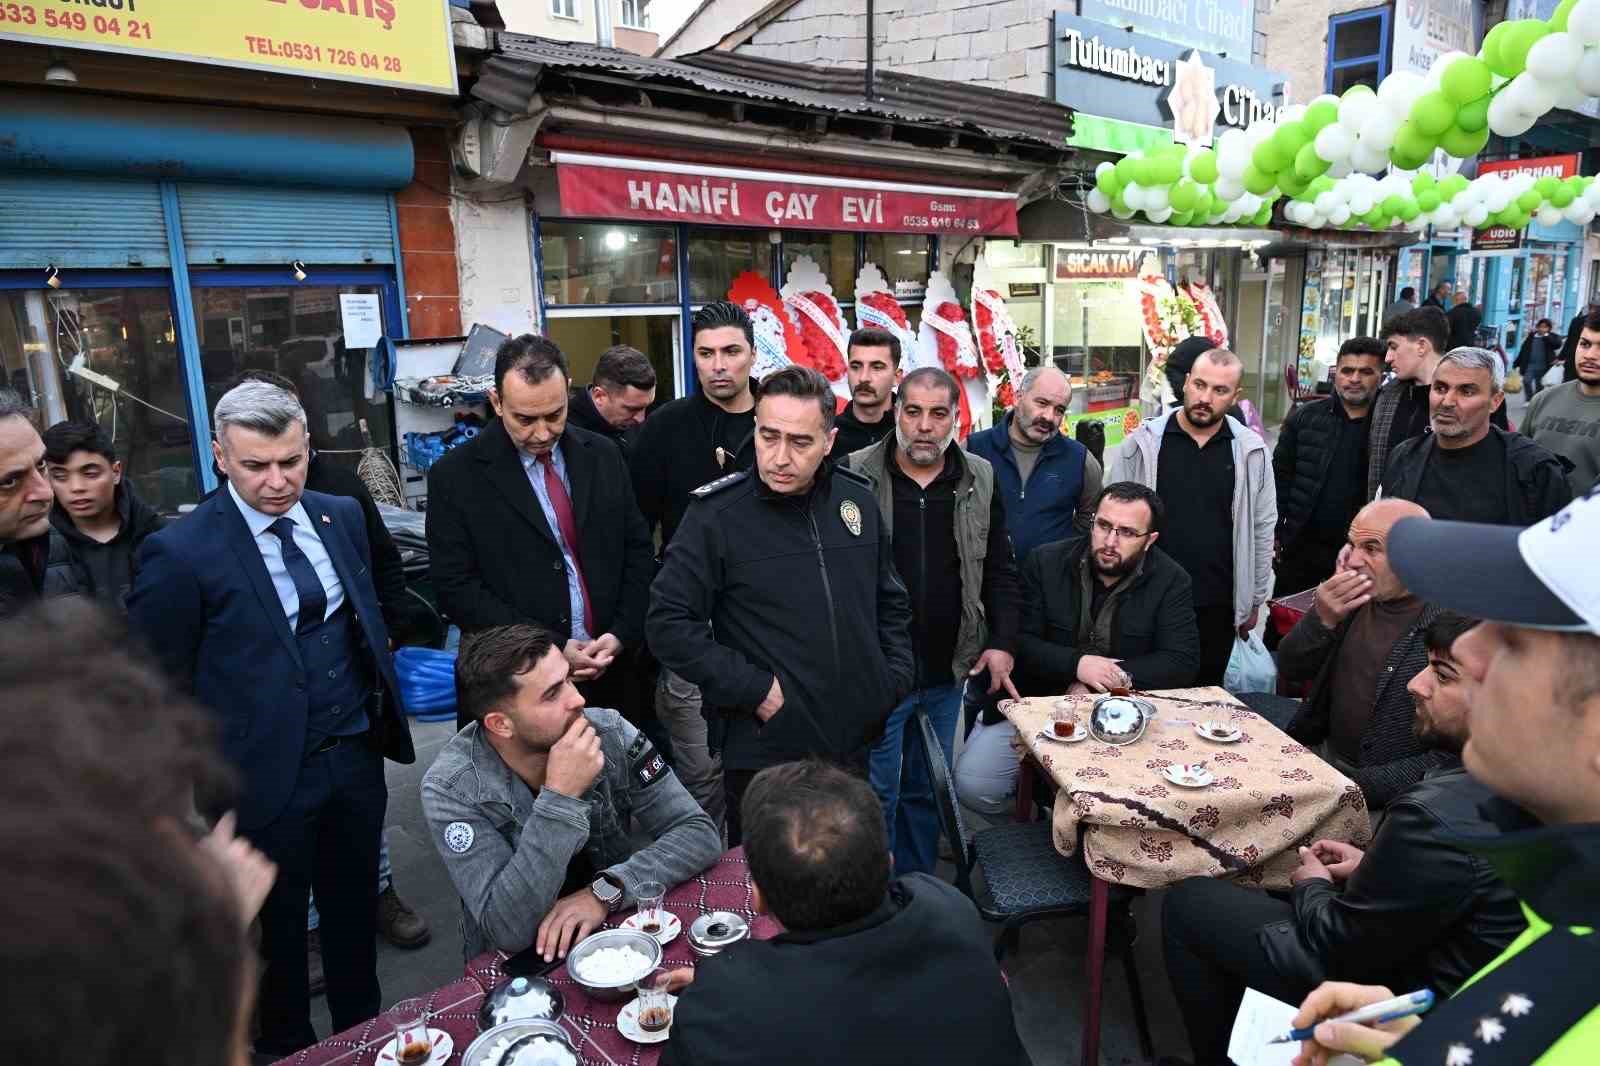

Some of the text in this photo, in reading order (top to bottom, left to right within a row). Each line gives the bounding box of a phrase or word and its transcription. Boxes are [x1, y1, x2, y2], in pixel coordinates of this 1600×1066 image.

[44, 8, 86, 31] 549
[93, 15, 120, 35] 04
[127, 20, 152, 39] 21
[245, 35, 402, 72] TEL:0531 726 04 28
[1065, 28, 1170, 86] Tulumbacı
[627, 179, 884, 225] HANİFİ ÇAY EVİ
[1067, 253, 1110, 273] SICAK
